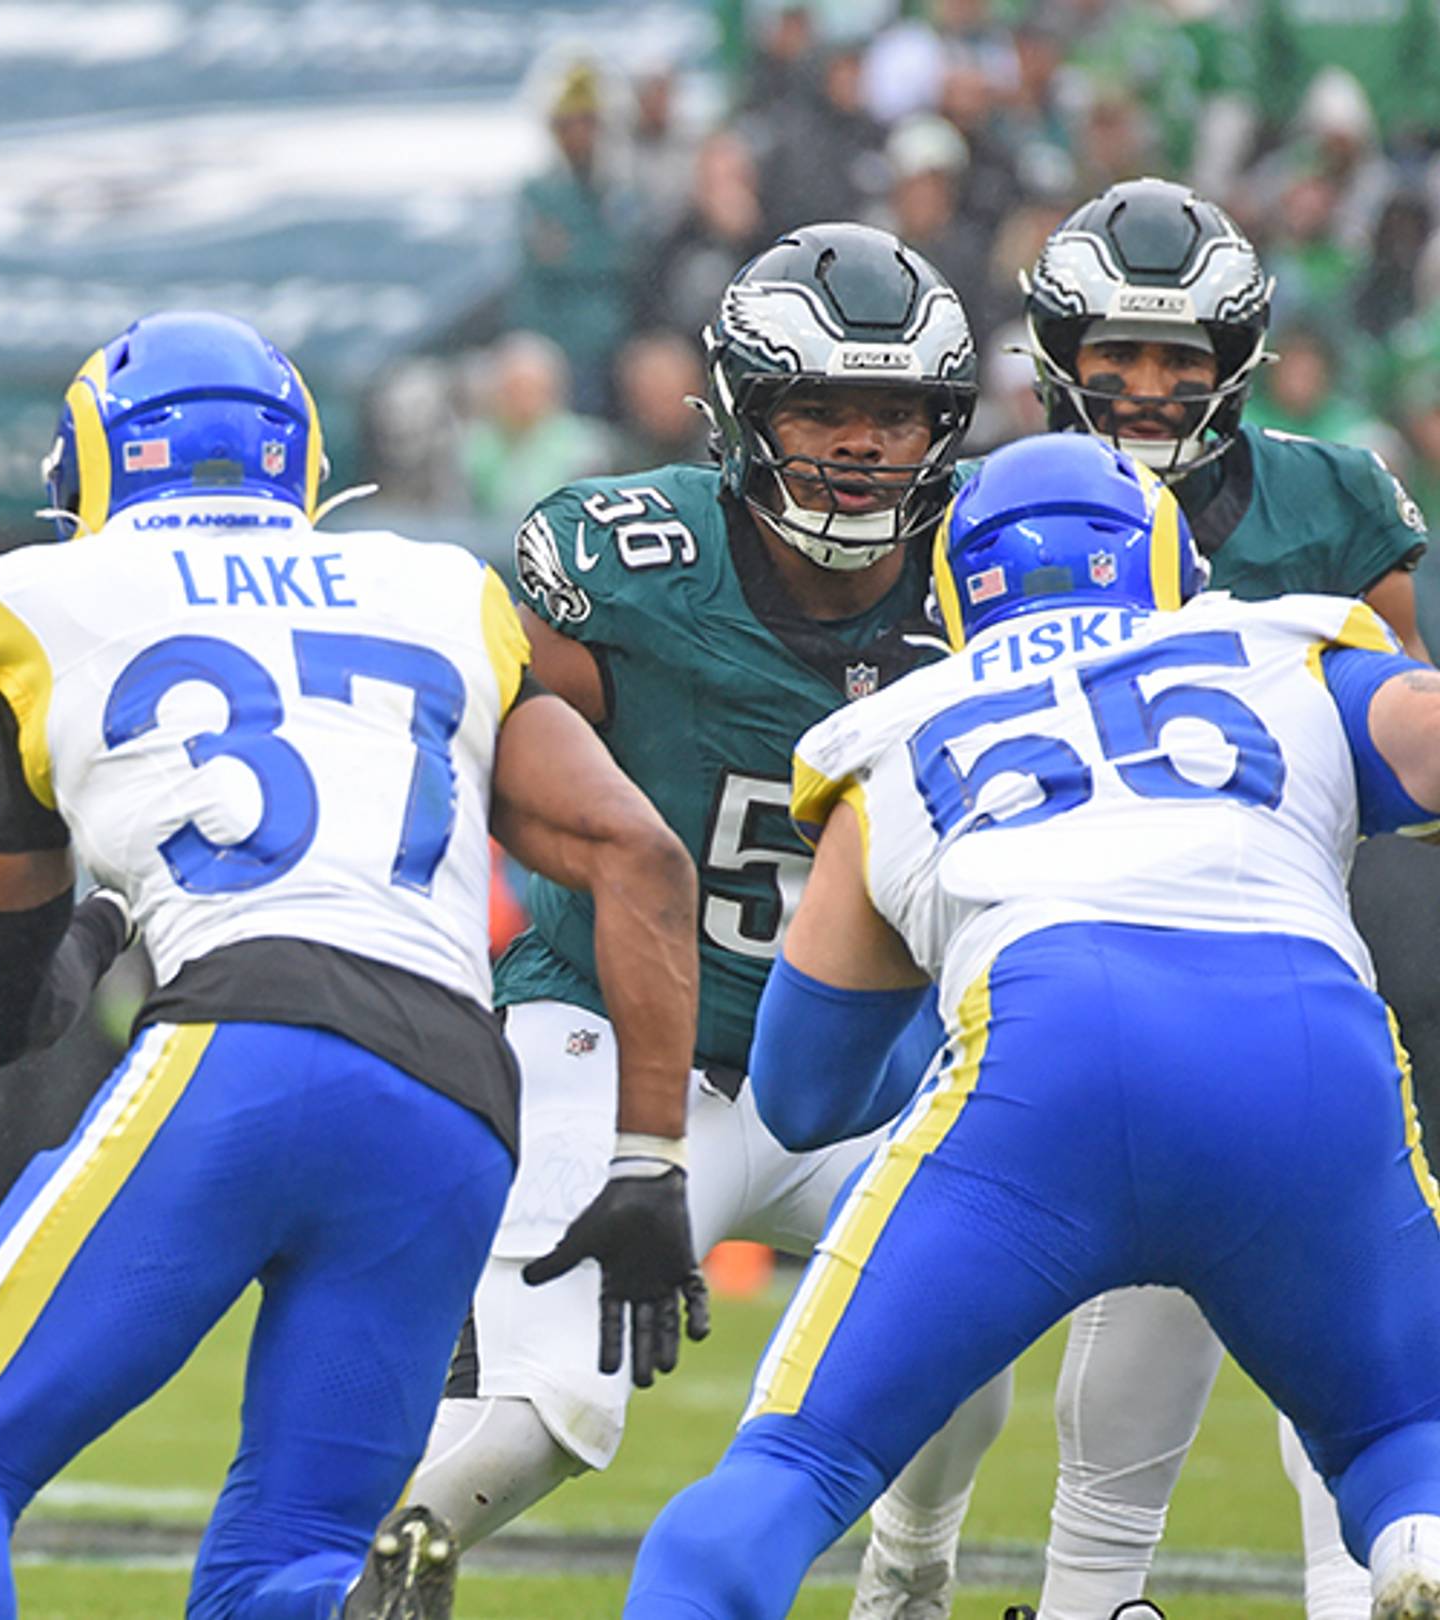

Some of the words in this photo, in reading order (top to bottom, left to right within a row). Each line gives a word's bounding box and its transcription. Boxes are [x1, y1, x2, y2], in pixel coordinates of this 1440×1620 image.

[133, 514, 182, 531] LOS
[186, 512, 293, 530] ANGELES
[582, 486, 698, 568] 56
[172, 550, 358, 608] LAKE
[102, 628, 467, 899] 37
[906, 629, 1288, 842] 55
